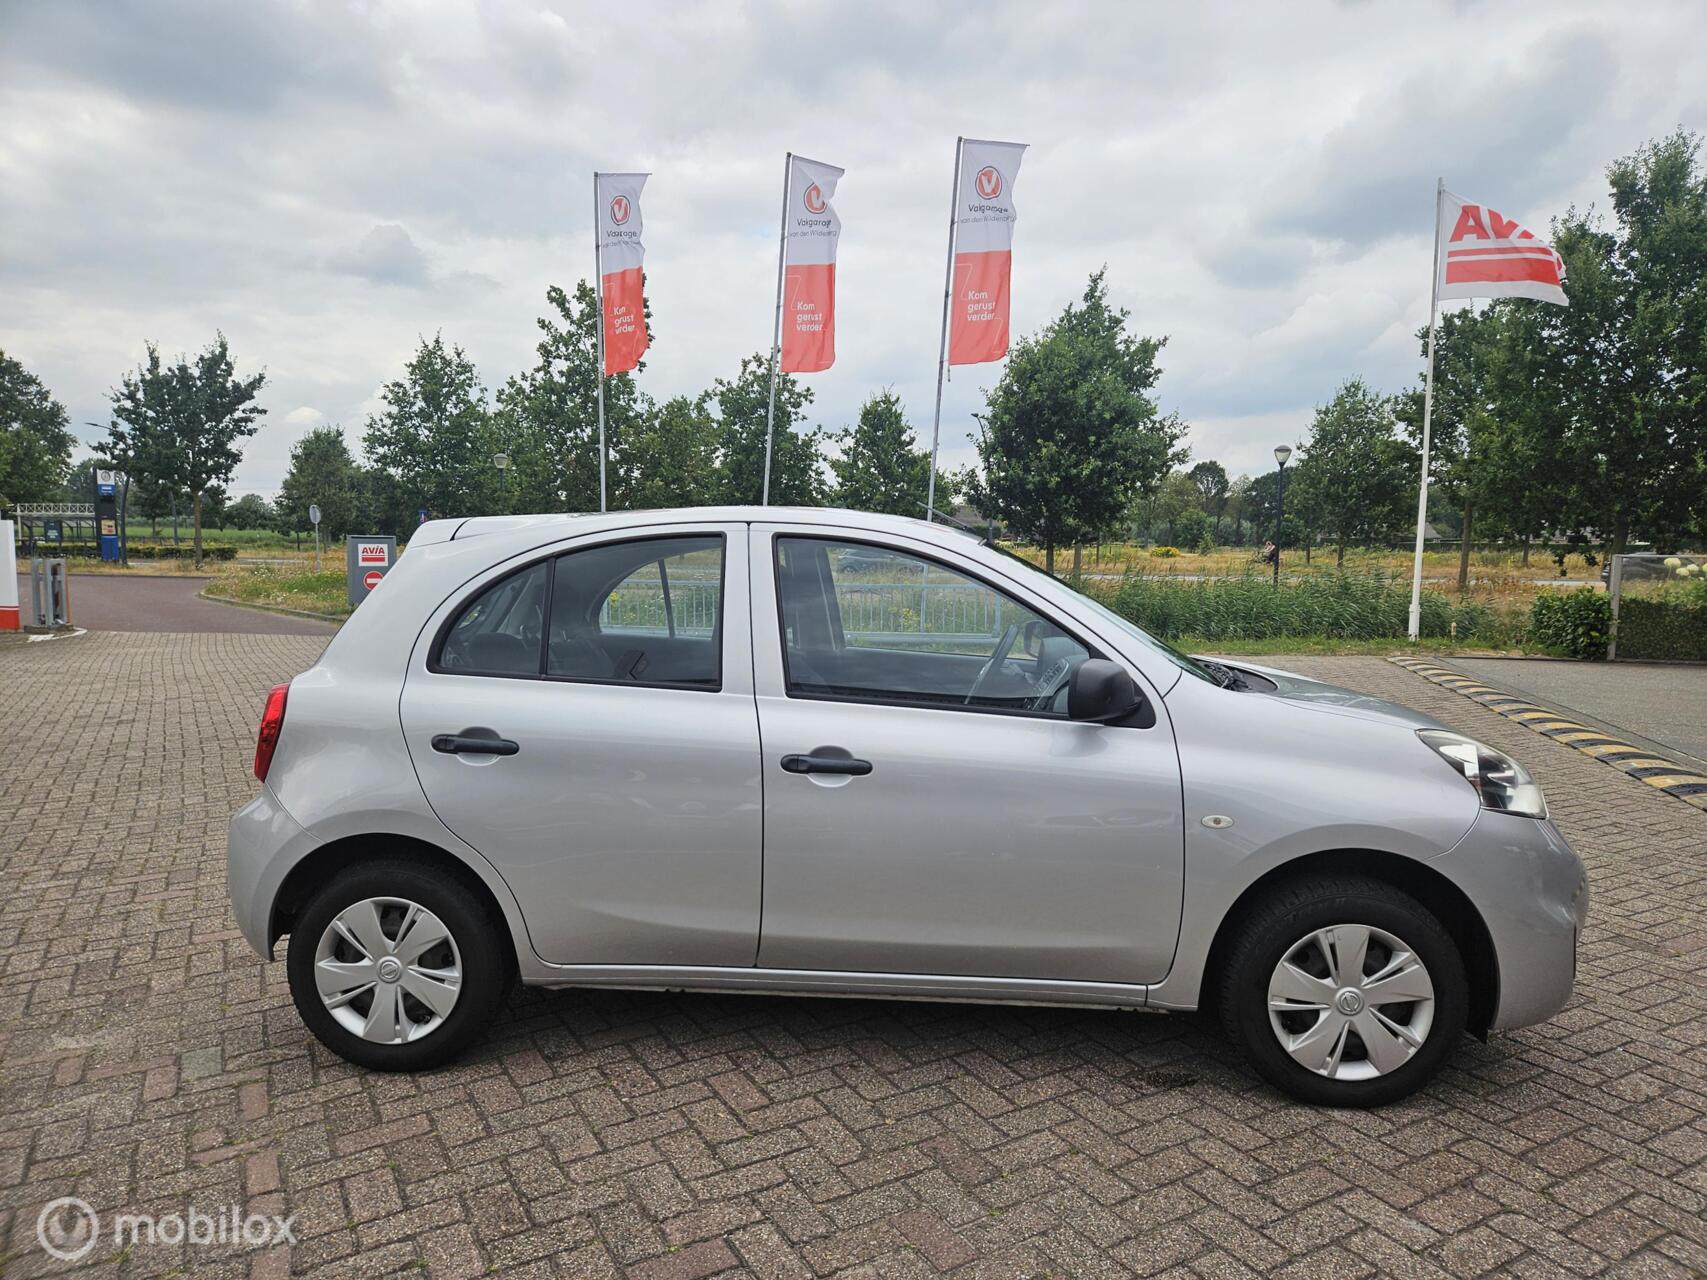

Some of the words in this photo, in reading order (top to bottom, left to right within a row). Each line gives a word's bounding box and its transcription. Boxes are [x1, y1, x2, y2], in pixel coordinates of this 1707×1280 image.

[968, 290, 988, 301] Kom
[797, 300, 815, 311] Kom
[967, 301, 995, 313] gerust
[967, 311, 995, 321] verder
